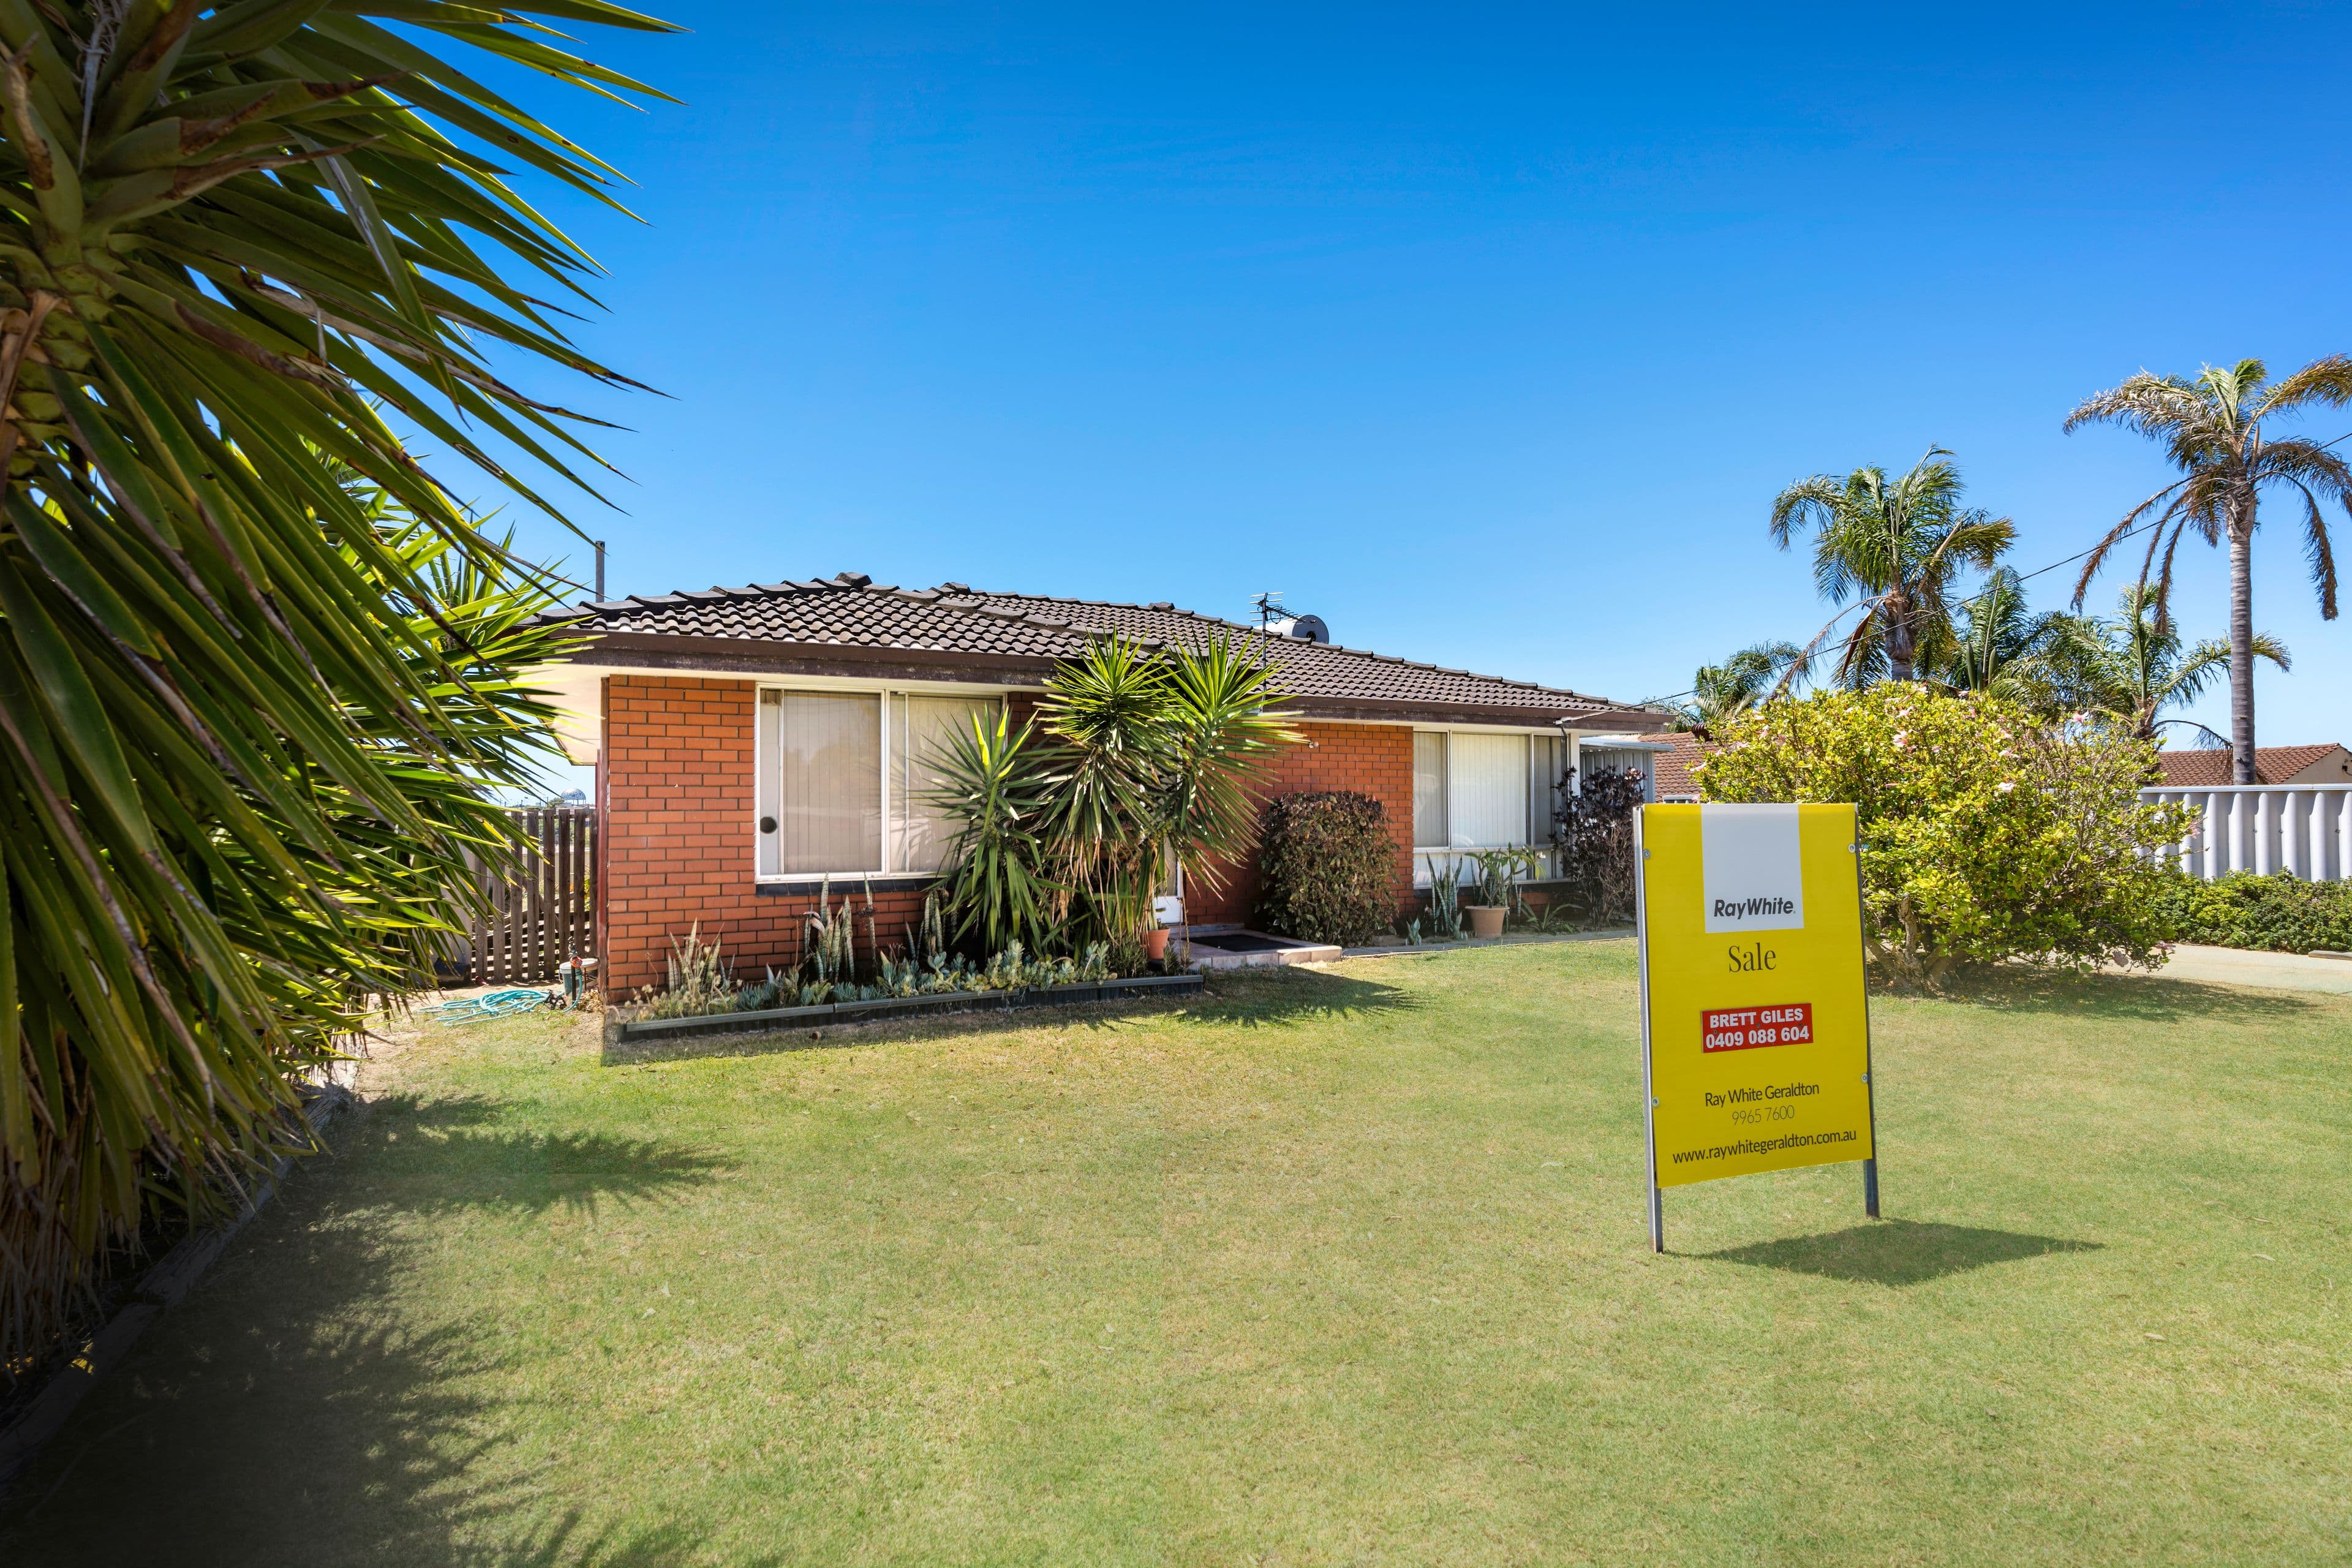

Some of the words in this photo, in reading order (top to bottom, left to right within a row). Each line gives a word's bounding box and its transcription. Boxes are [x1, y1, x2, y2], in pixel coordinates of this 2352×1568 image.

[1728, 942, 1777, 973] Sale
[1709, 1012, 1757, 1028] BRETT
[1760, 1008, 1803, 1023] GILES
[1706, 1031, 1743, 1049] 0409
[1748, 1029, 1776, 1044] 088
[1781, 1026, 1809, 1041] 604
[1705, 1092, 1726, 1107] Ray
[1728, 1087, 1762, 1103] White
[1765, 1082, 1820, 1099] Geraldton
[1732, 1109, 1762, 1126] 9965
[1765, 1105, 1795, 1121] 7600
[1673, 1130, 1856, 1164] www.raywhitegeraldton.com.au
